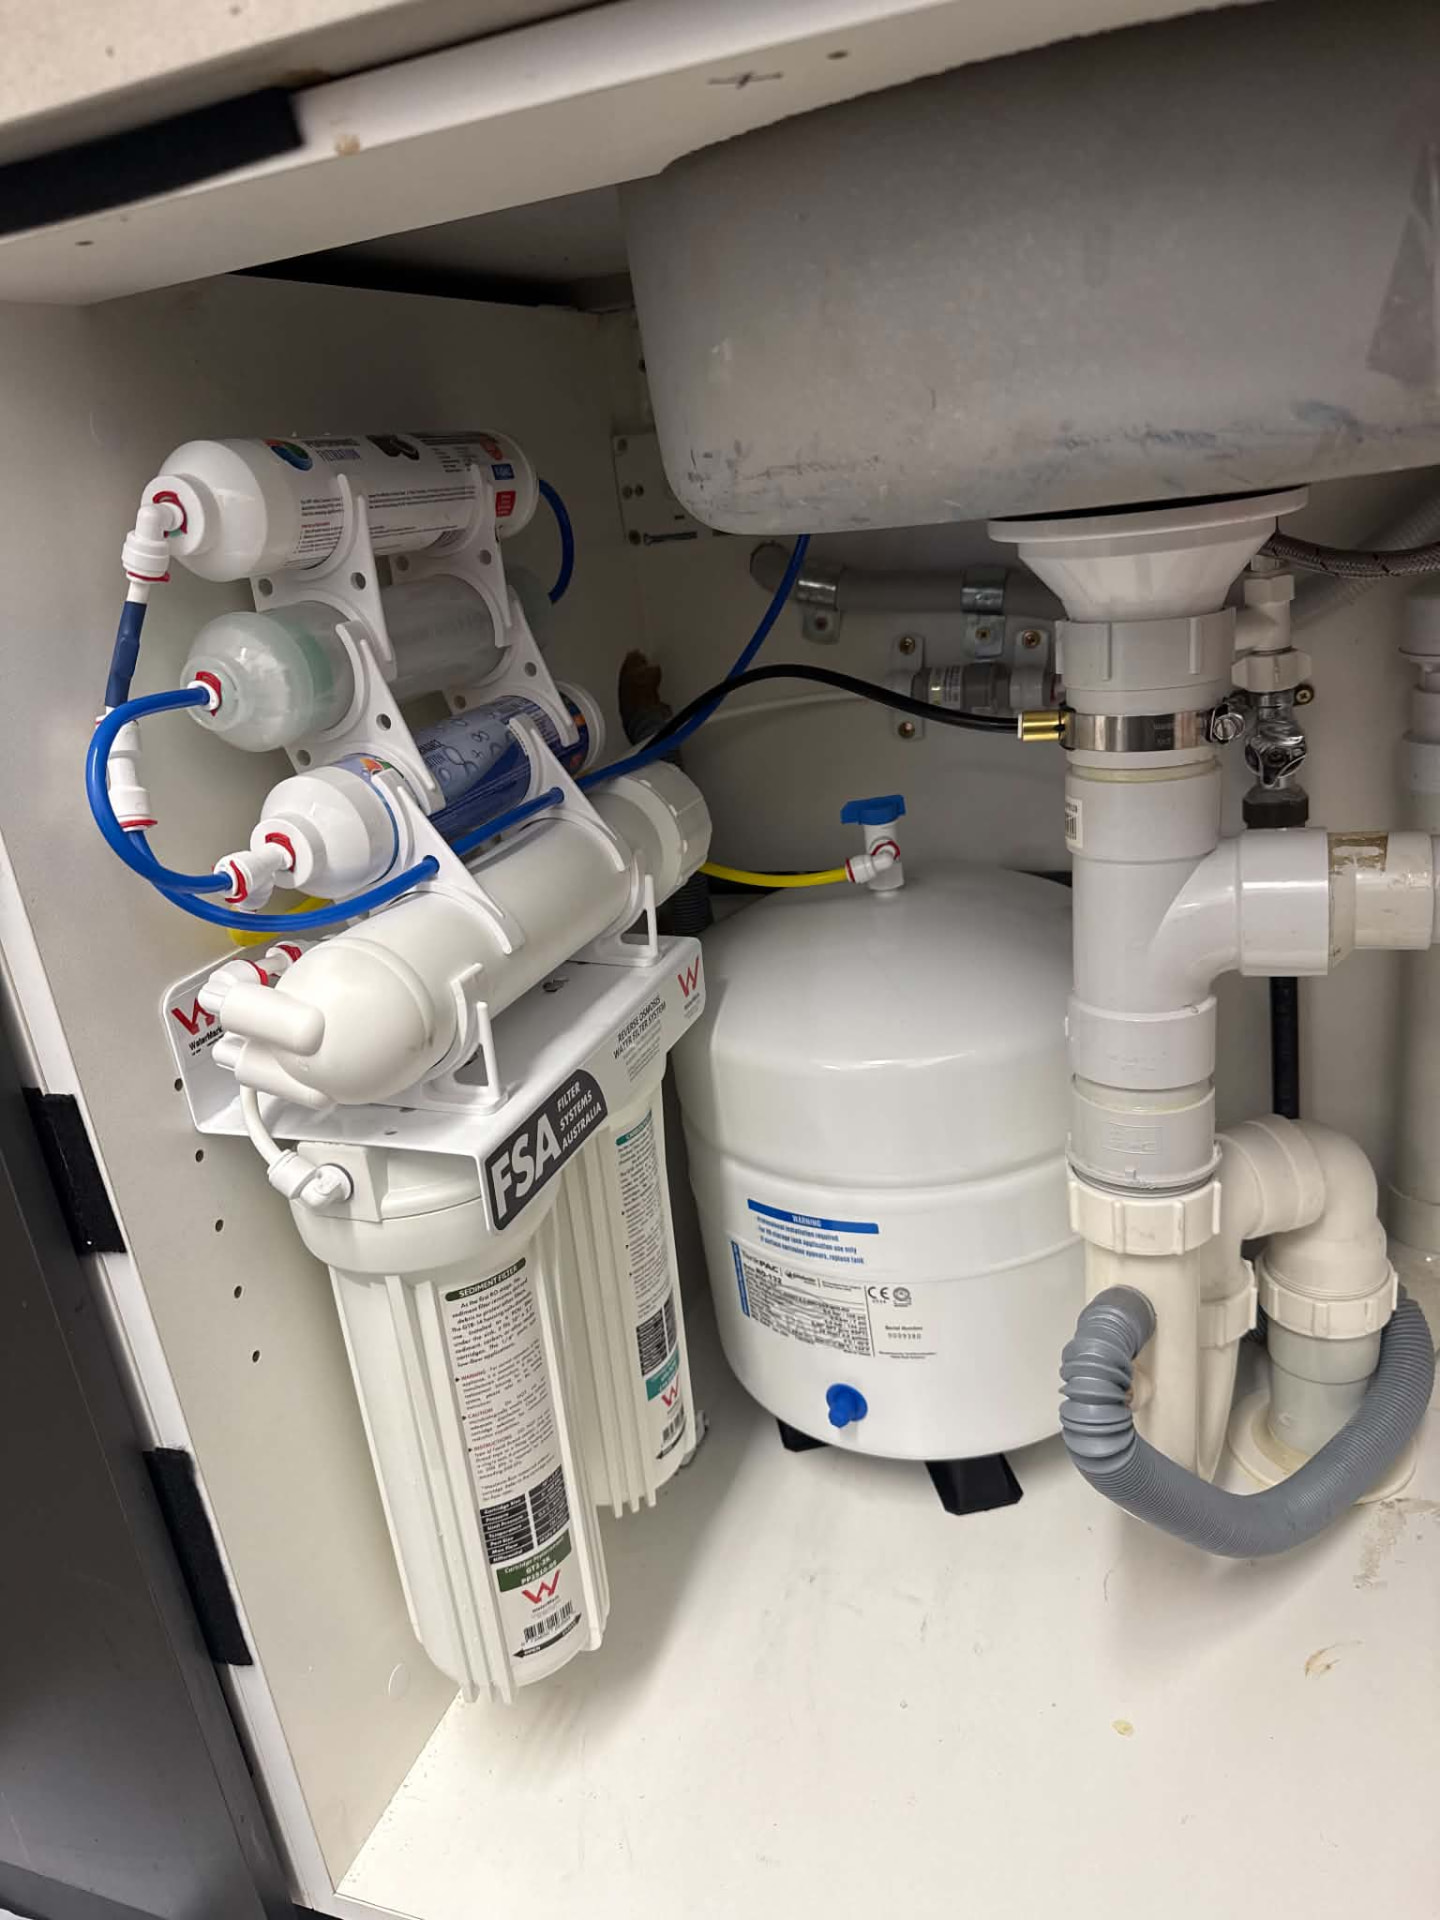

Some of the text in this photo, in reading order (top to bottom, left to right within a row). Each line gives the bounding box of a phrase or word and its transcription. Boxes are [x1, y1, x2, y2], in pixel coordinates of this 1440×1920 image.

[189, 1026, 223, 1051] WaterMark
[613, 1037, 632, 1059] WATER
[632, 1021, 648, 1040] FILTER
[648, 1001, 666, 1024] SYSTEM
[618, 1018, 640, 1042] REVERSE
[557, 1081, 581, 1112] FILTER
[560, 1089, 593, 1131] SYSTEMS
[562, 1102, 602, 1151] AUSTRALIA
[491, 1113, 562, 1220] FSA
[792, 1215, 822, 1228] WARNING
[459, 1265, 518, 1299] SEDIMENT FILTER
